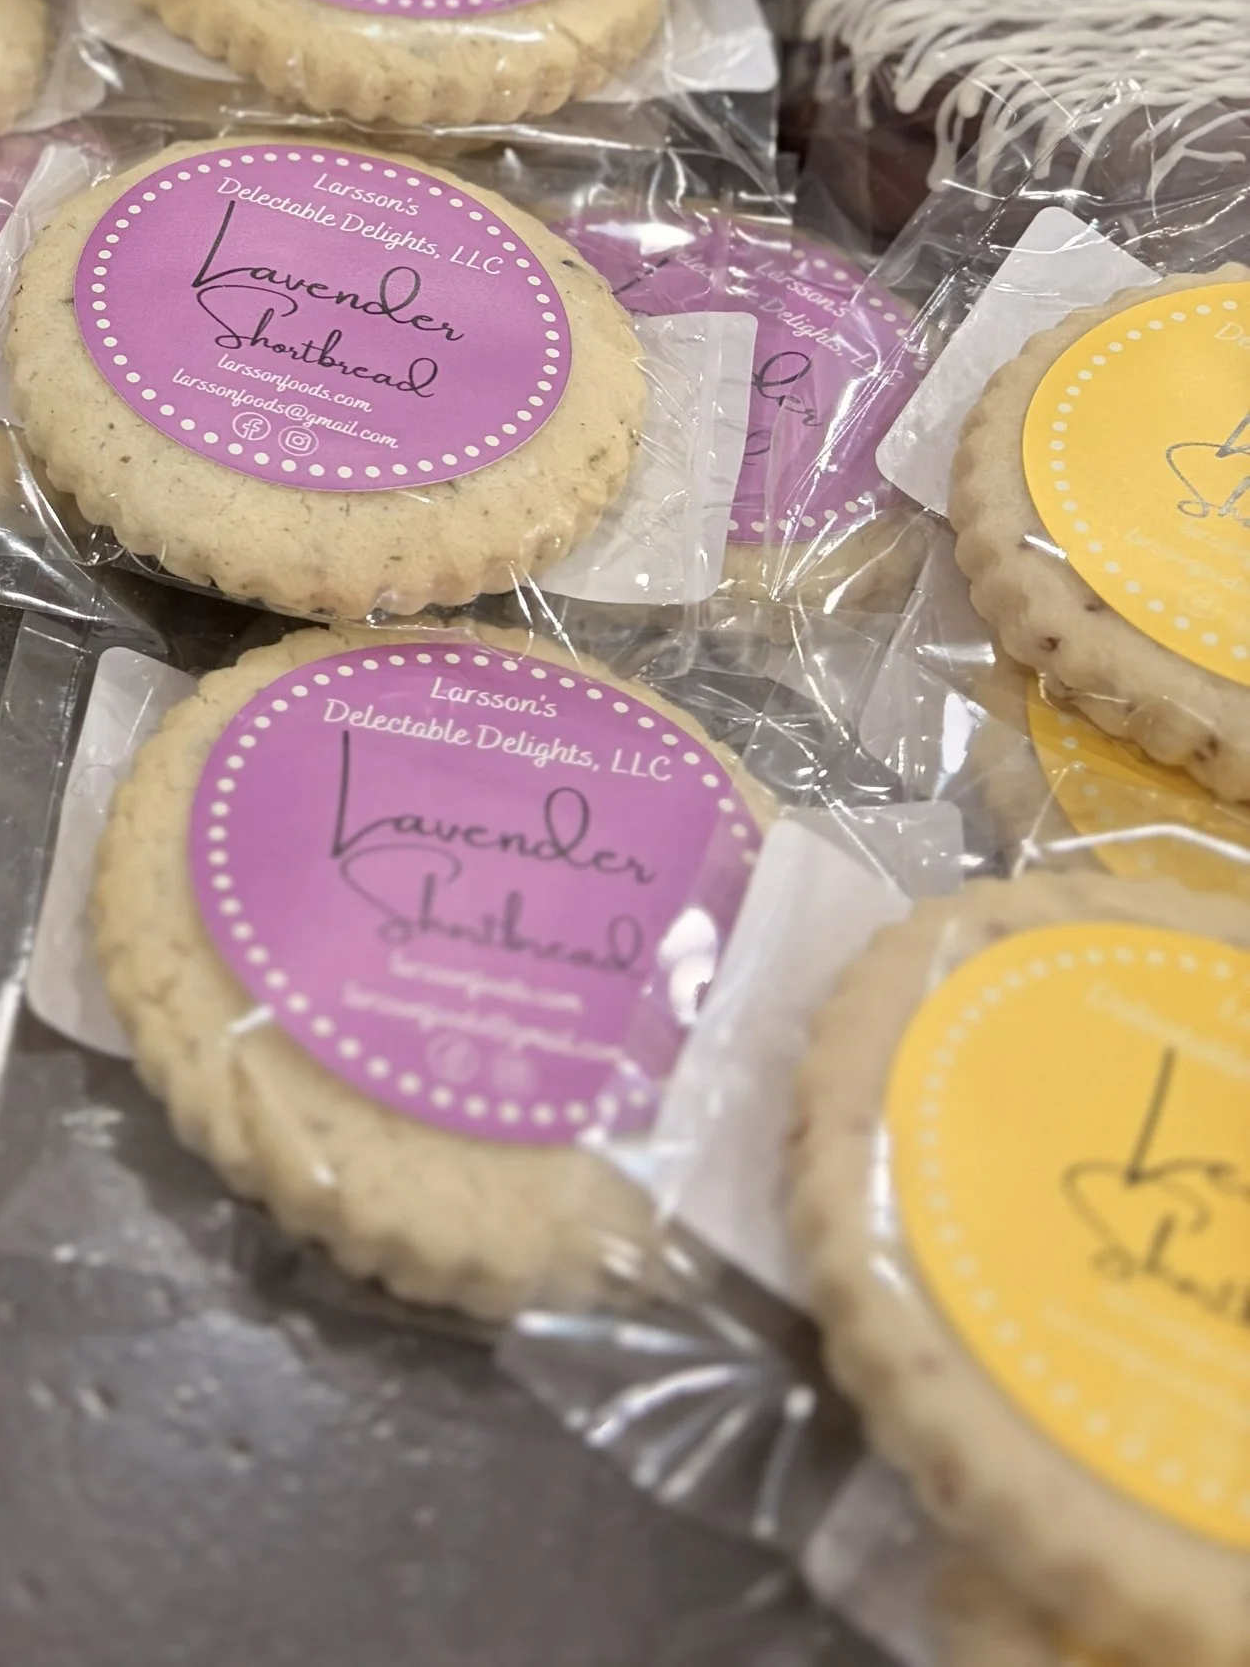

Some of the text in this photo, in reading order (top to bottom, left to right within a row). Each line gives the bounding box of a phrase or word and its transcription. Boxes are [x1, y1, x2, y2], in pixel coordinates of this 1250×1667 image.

[216, 176, 505, 275] Delectable Delights, LLC
[312, 172, 420, 216] Larsson's
[191, 200, 465, 342] Lavender
[196, 284, 439, 398] Shortbread
[217, 353, 373, 413] larssonfoods.com
[172, 368, 399, 449] larssonfoods@gmail.com
[430, 676, 558, 719] Larsson's
[323, 698, 673, 782] Delectable Delights, LLC
[330, 729, 655, 885] Lavender
